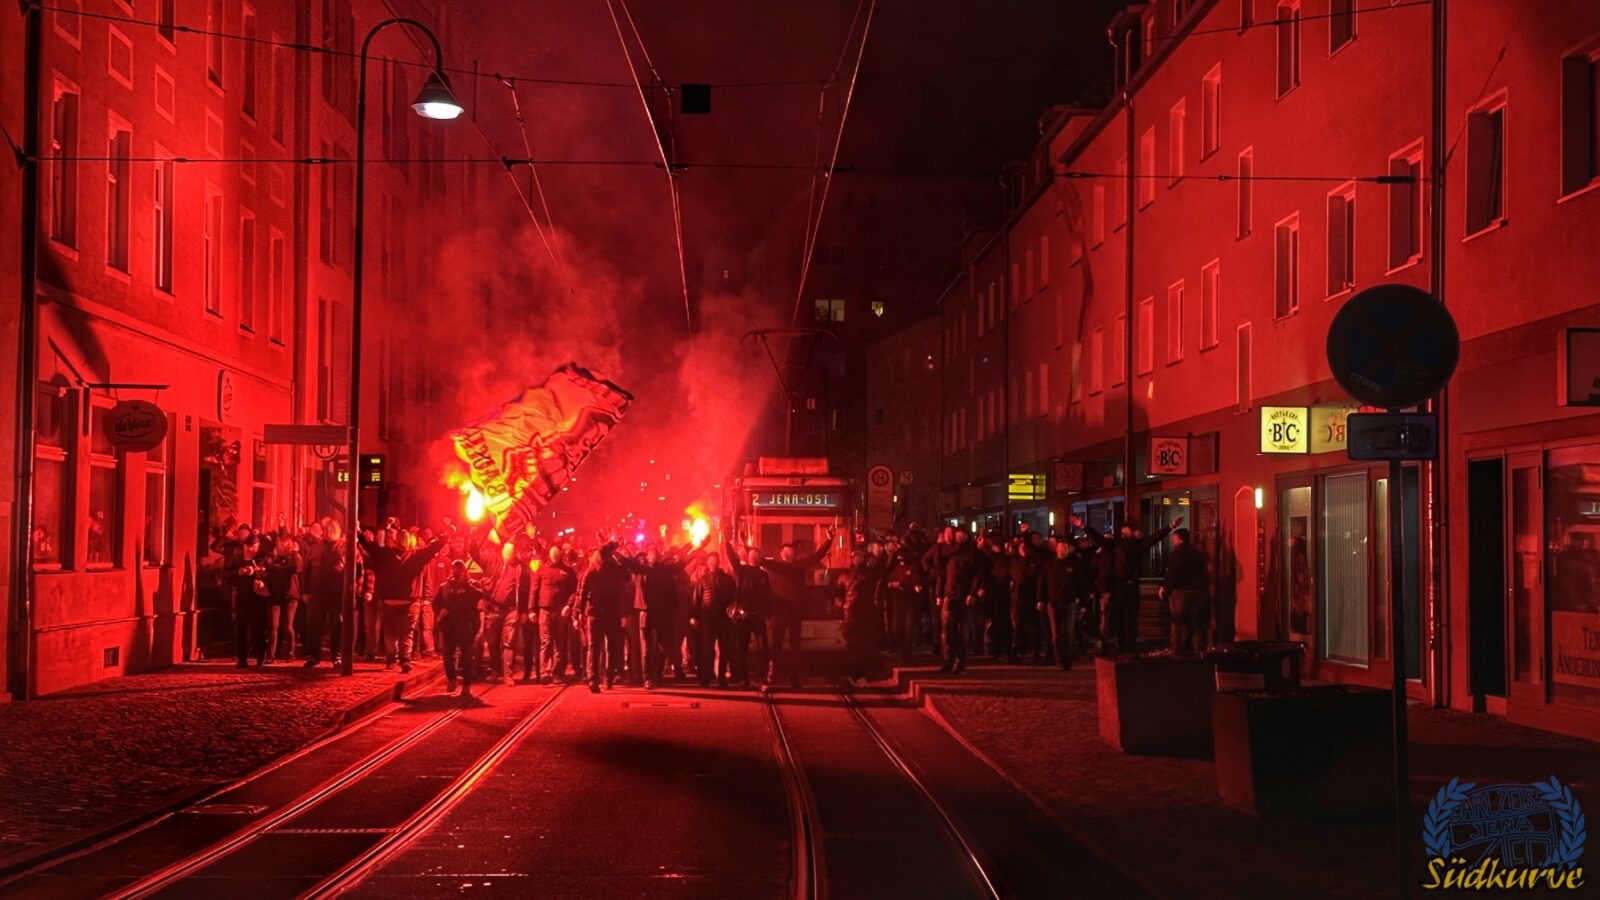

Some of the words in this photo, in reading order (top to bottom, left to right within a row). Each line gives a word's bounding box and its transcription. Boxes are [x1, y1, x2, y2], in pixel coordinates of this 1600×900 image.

[1273, 423, 1296, 442] BC
[1160, 451, 1179, 466] BC
[752, 493, 760, 506] 2
[769, 493, 829, 505] JENA-OST
